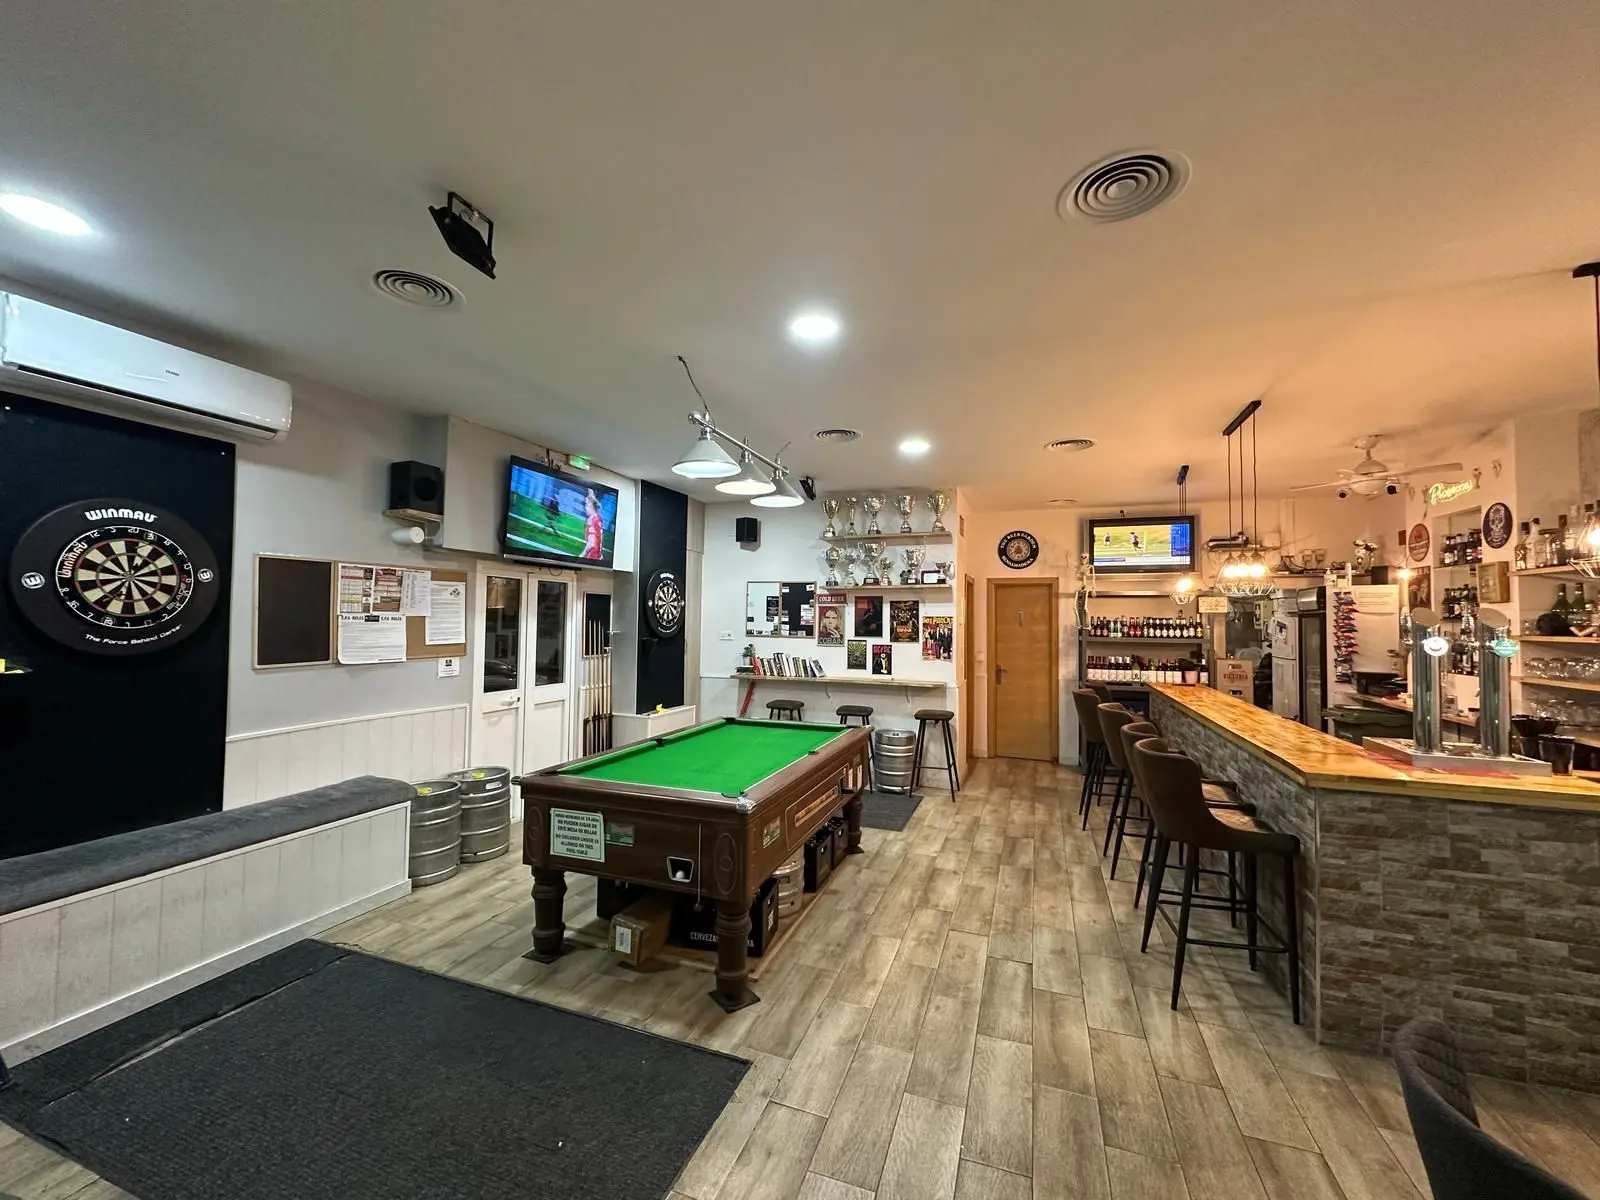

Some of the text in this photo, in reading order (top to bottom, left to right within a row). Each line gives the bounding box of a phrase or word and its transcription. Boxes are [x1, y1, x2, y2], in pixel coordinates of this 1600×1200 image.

[84, 508, 158, 523] WINMAU
[130, 635, 158, 645] Behind
[818, 637, 844, 645] COBAIN
